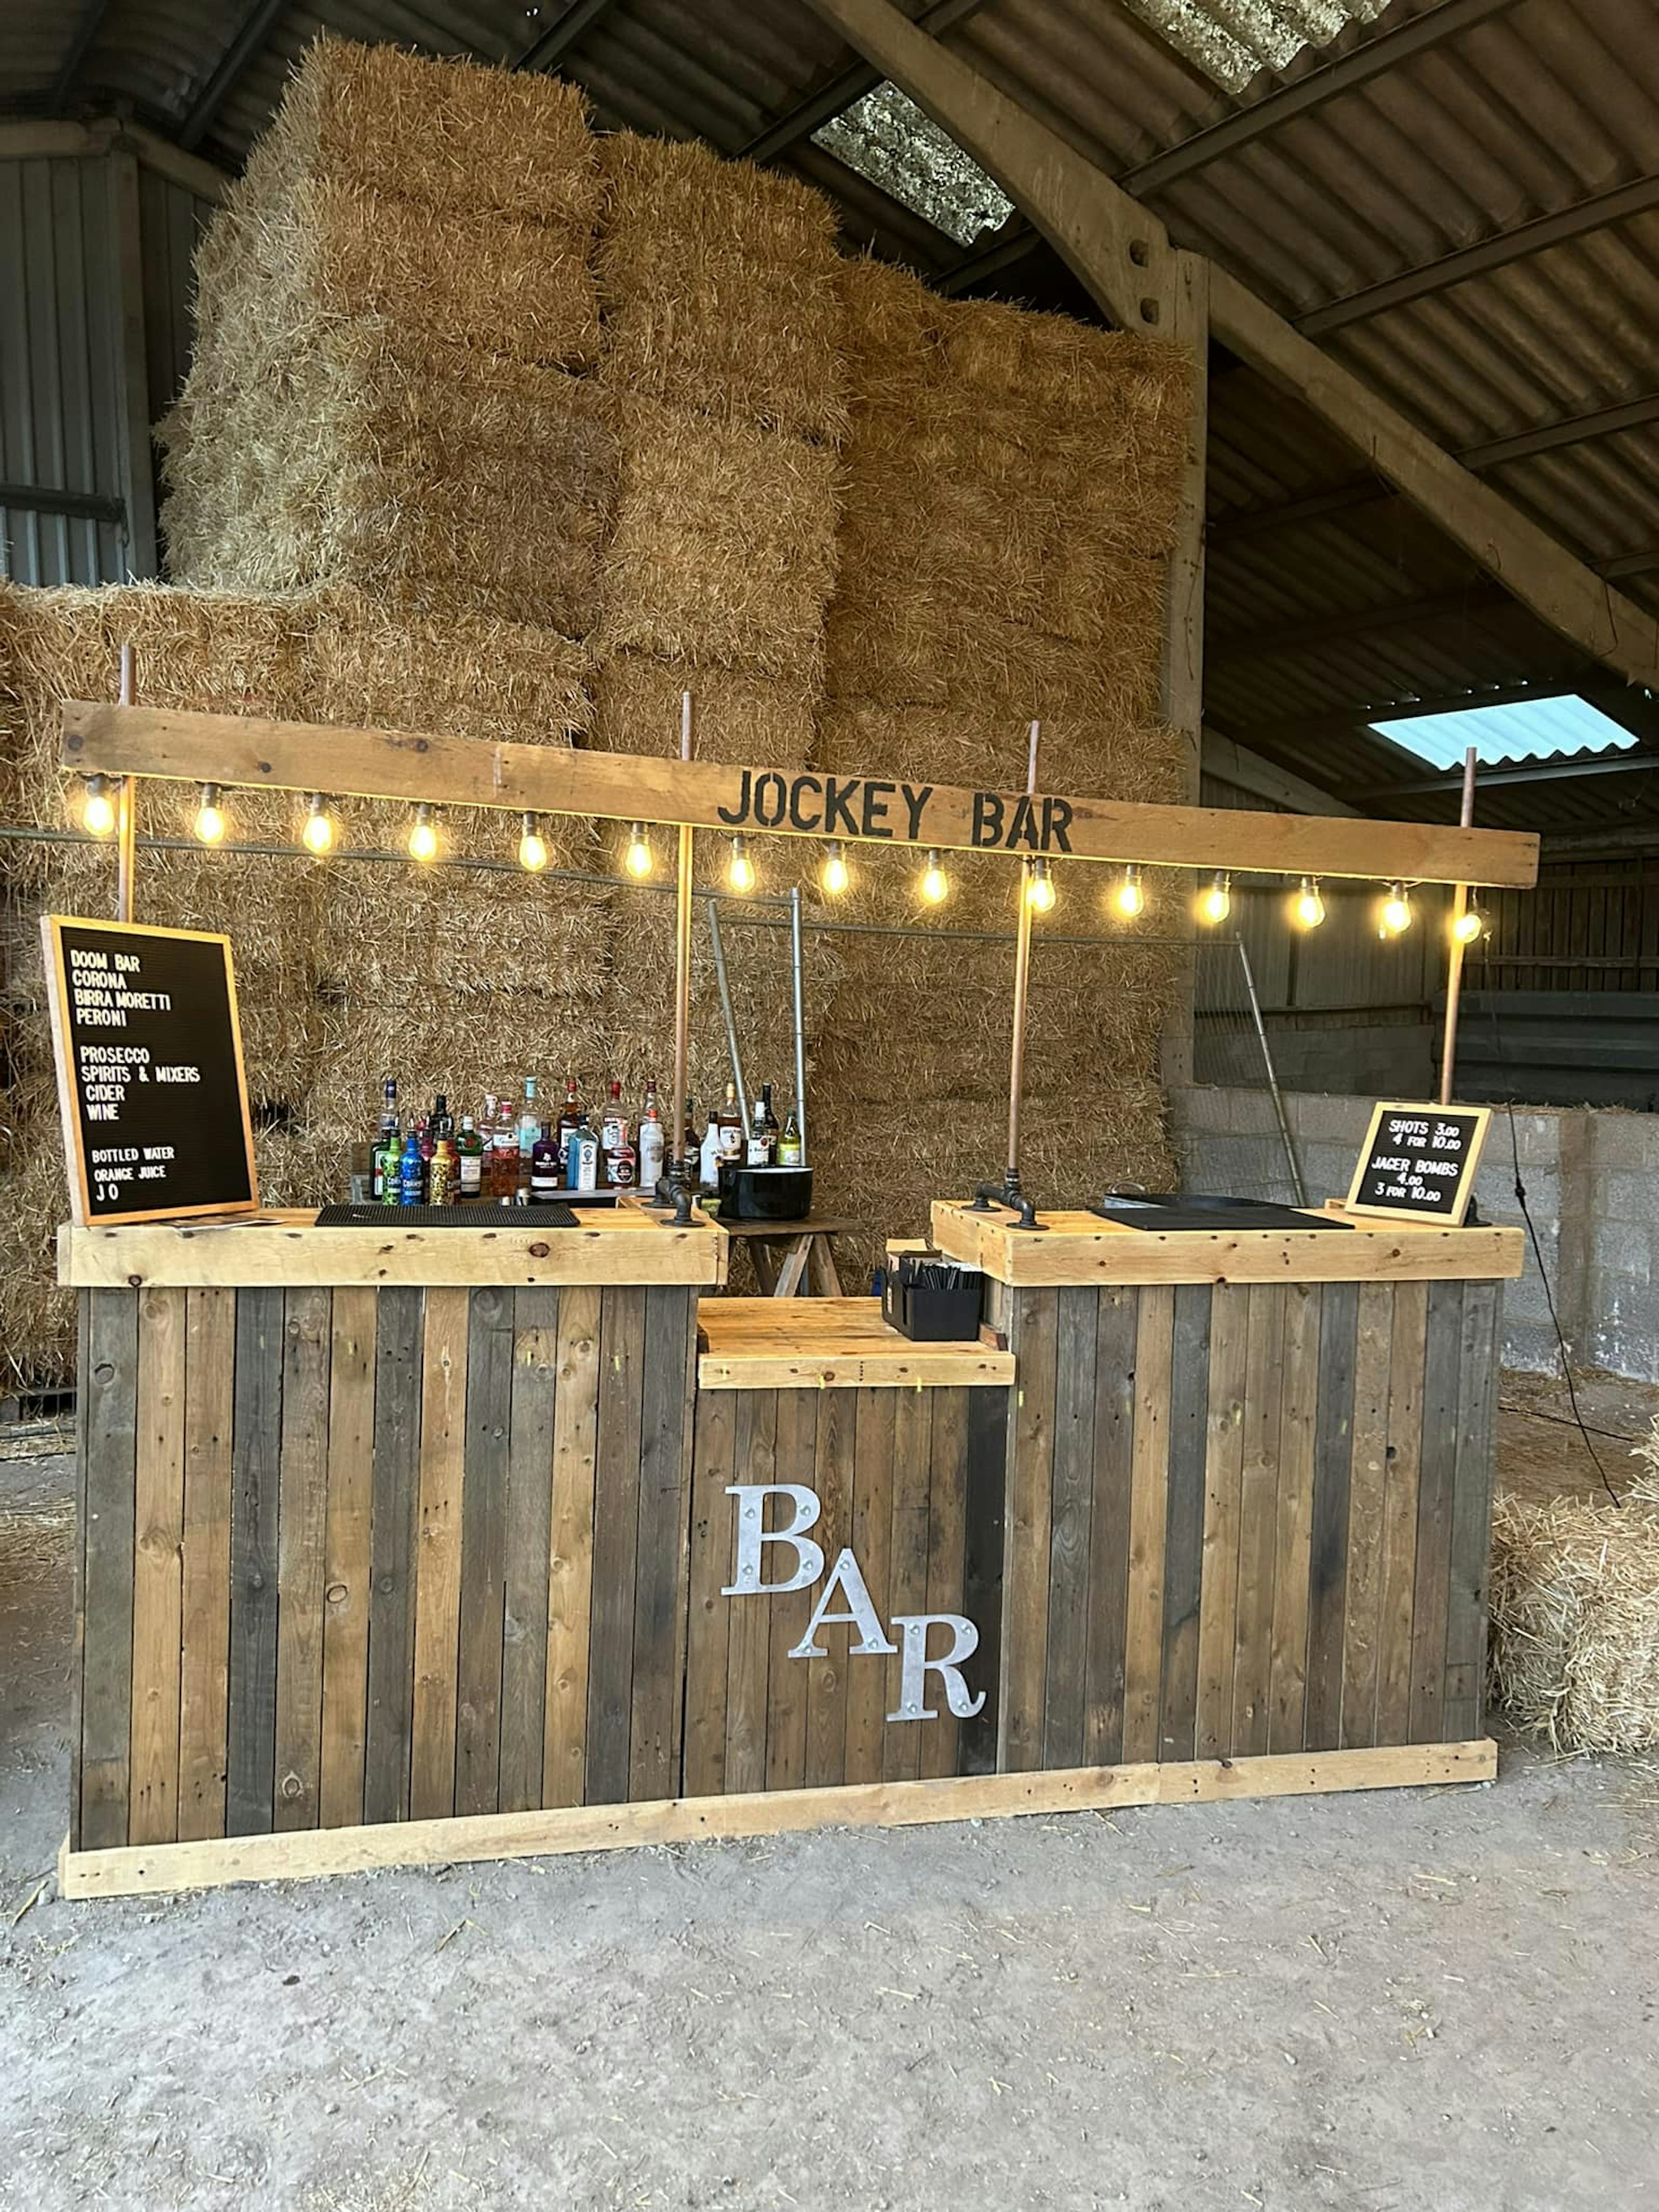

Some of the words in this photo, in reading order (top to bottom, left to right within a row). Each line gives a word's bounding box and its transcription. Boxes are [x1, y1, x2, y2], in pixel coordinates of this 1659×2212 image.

[718, 770, 933, 839] JOCKEY
[972, 792, 1073, 852] BAR
[70, 950, 108, 969] DOOM
[114, 953, 140, 973] BAR
[72, 969, 127, 990] CORONA
[74, 988, 114, 1007] BIRRA
[115, 991, 172, 1011] MORETTI
[76, 1007, 127, 1027] PERONI
[80, 1046, 150, 1063] PROSECCO
[81, 1065, 131, 1082] SPIRITS
[139, 1065, 149, 1082] &
[155, 1066, 200, 1082] MIXERS
[86, 1084, 125, 1102] CIDER
[86, 1103, 120, 1121] WINE
[1389, 1119, 1429, 1135] SHOTS
[1434, 1123, 1460, 1137] 3.00
[1392, 1133, 1403, 1145] 4
[1407, 1136, 1427, 1147] FOR
[1432, 1135, 1462, 1150] 10.00
[92, 1148, 139, 1163] BOTTLED
[143, 1146, 175, 1160] WATER
[94, 1167, 134, 1182] ORANGE
[138, 1165, 166, 1179] JUICE
[1371, 1156, 1411, 1172] JAGER
[1415, 1159, 1459, 1176] BOMBS
[1397, 1172, 1423, 1185] 4.00
[1375, 1182, 1385, 1195] 3
[1386, 1185, 1406, 1198] FOR
[1411, 1186, 1441, 1201] 10.00
[721, 1484, 986, 1722] BAR
